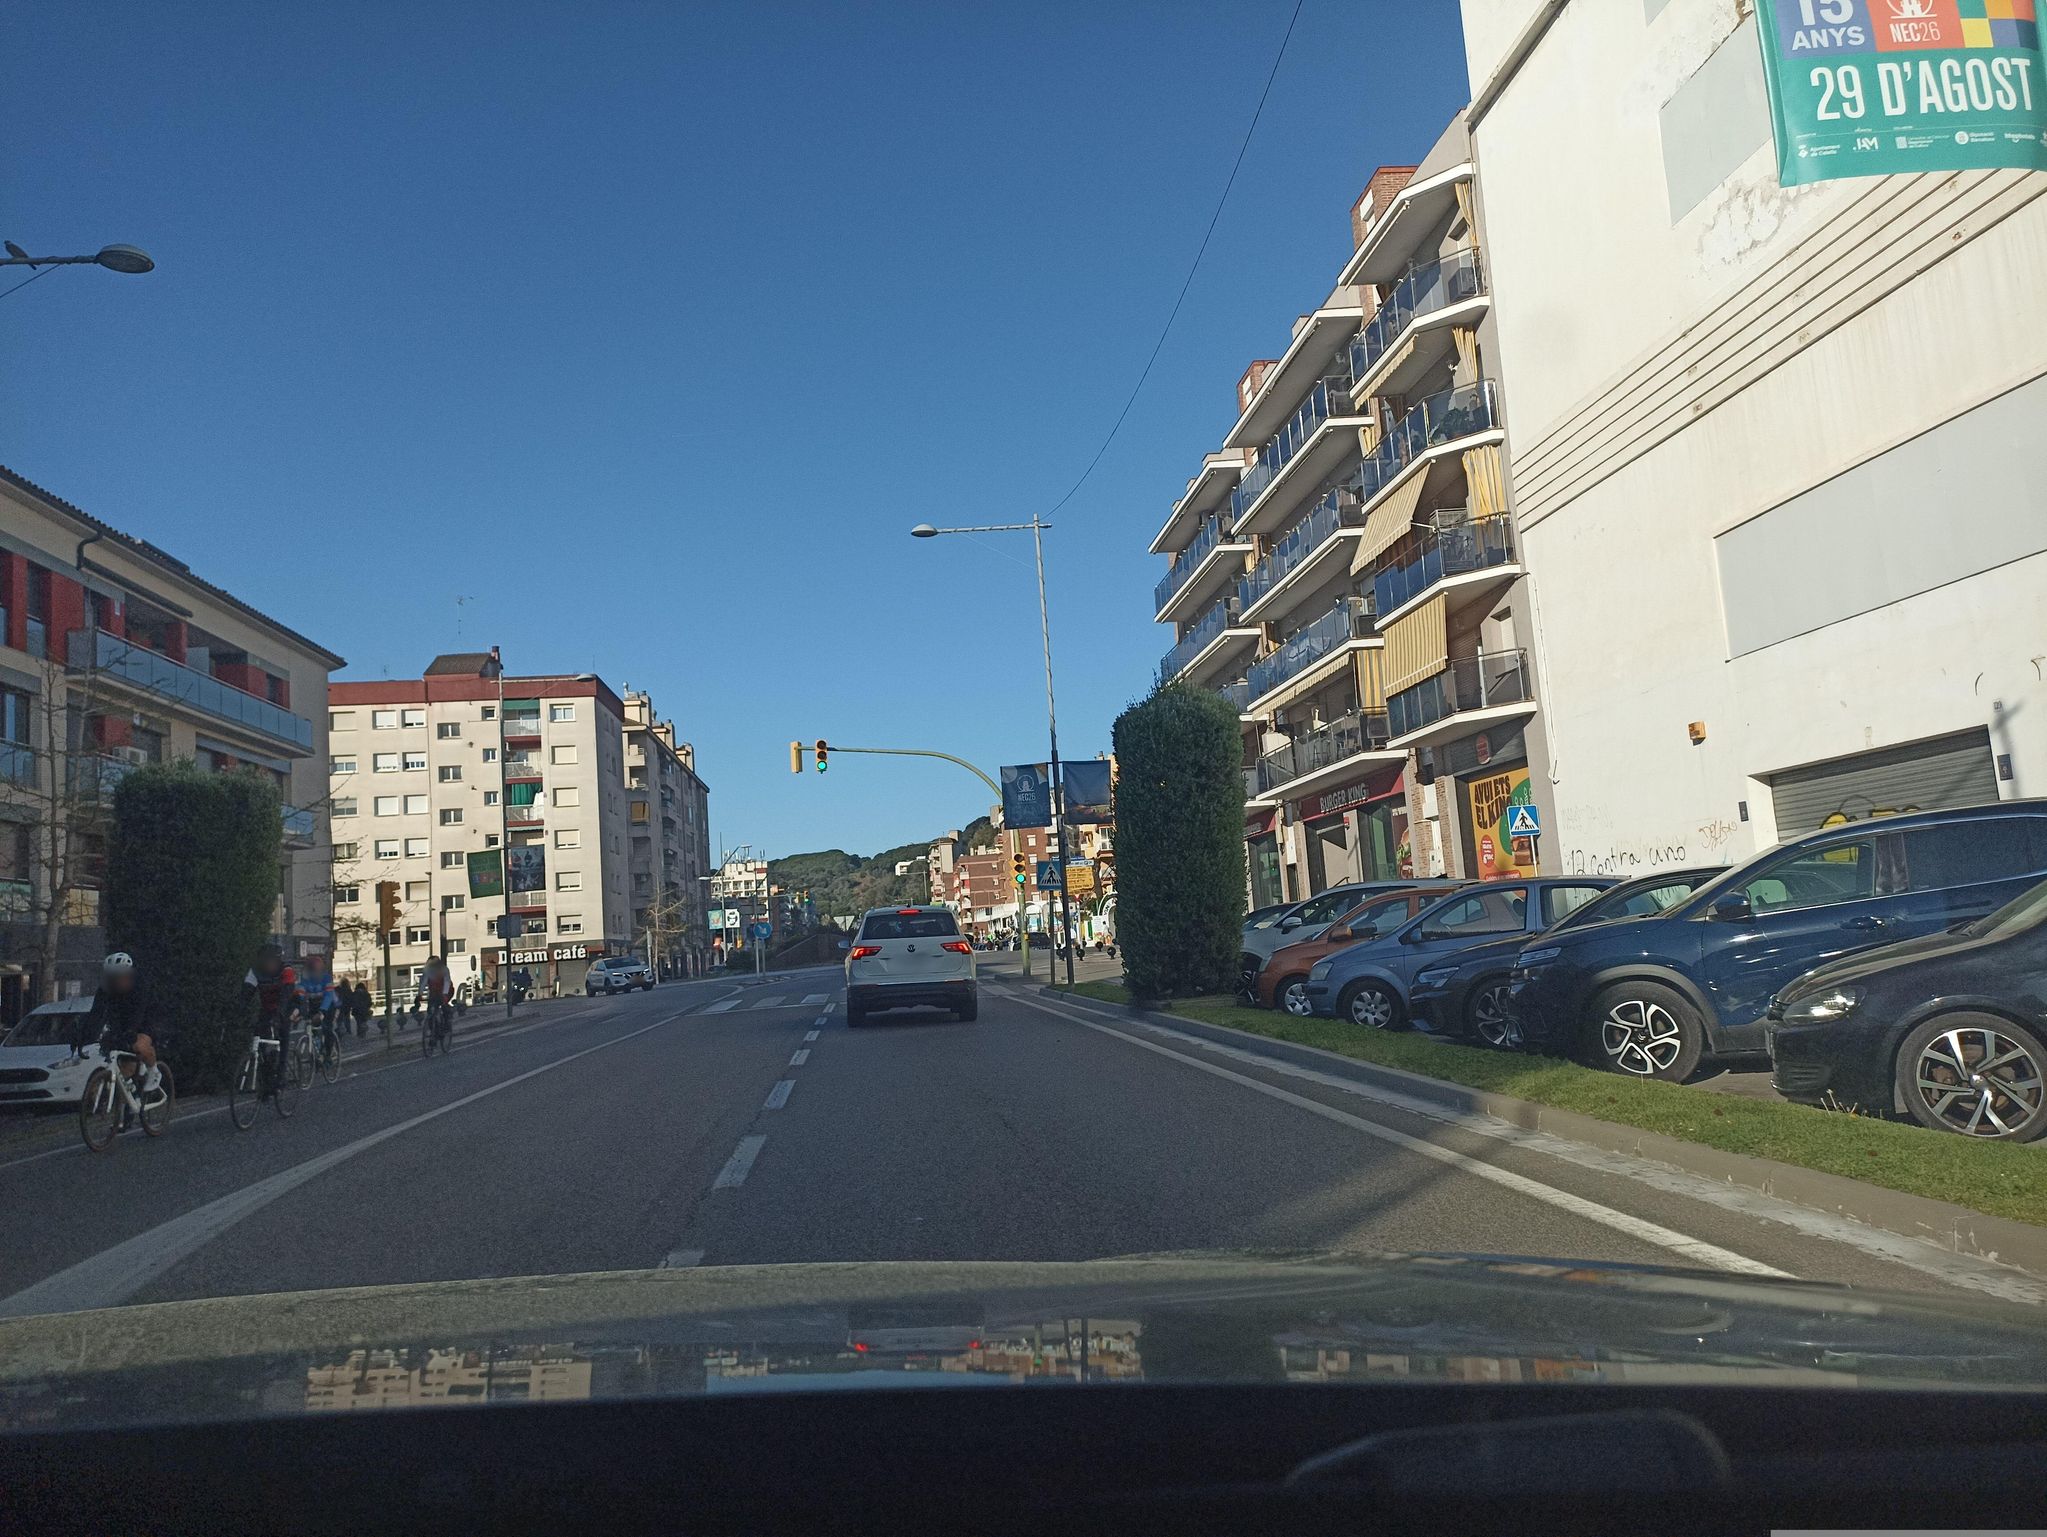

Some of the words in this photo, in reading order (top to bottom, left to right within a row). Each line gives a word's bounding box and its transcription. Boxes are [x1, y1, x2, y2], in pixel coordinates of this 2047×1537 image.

[1791, 26, 1865, 51] ANYS
[1889, 21, 1941, 43] NEC26
[1810, 65, 1865, 121] 29
[1877, 57, 2032, 116] D'AGOST
[1320, 790, 1346, 812] BURGER
[1348, 782, 1367, 803] KING
[498, 950, 548, 965] Dream
[553, 944, 587, 960] café
